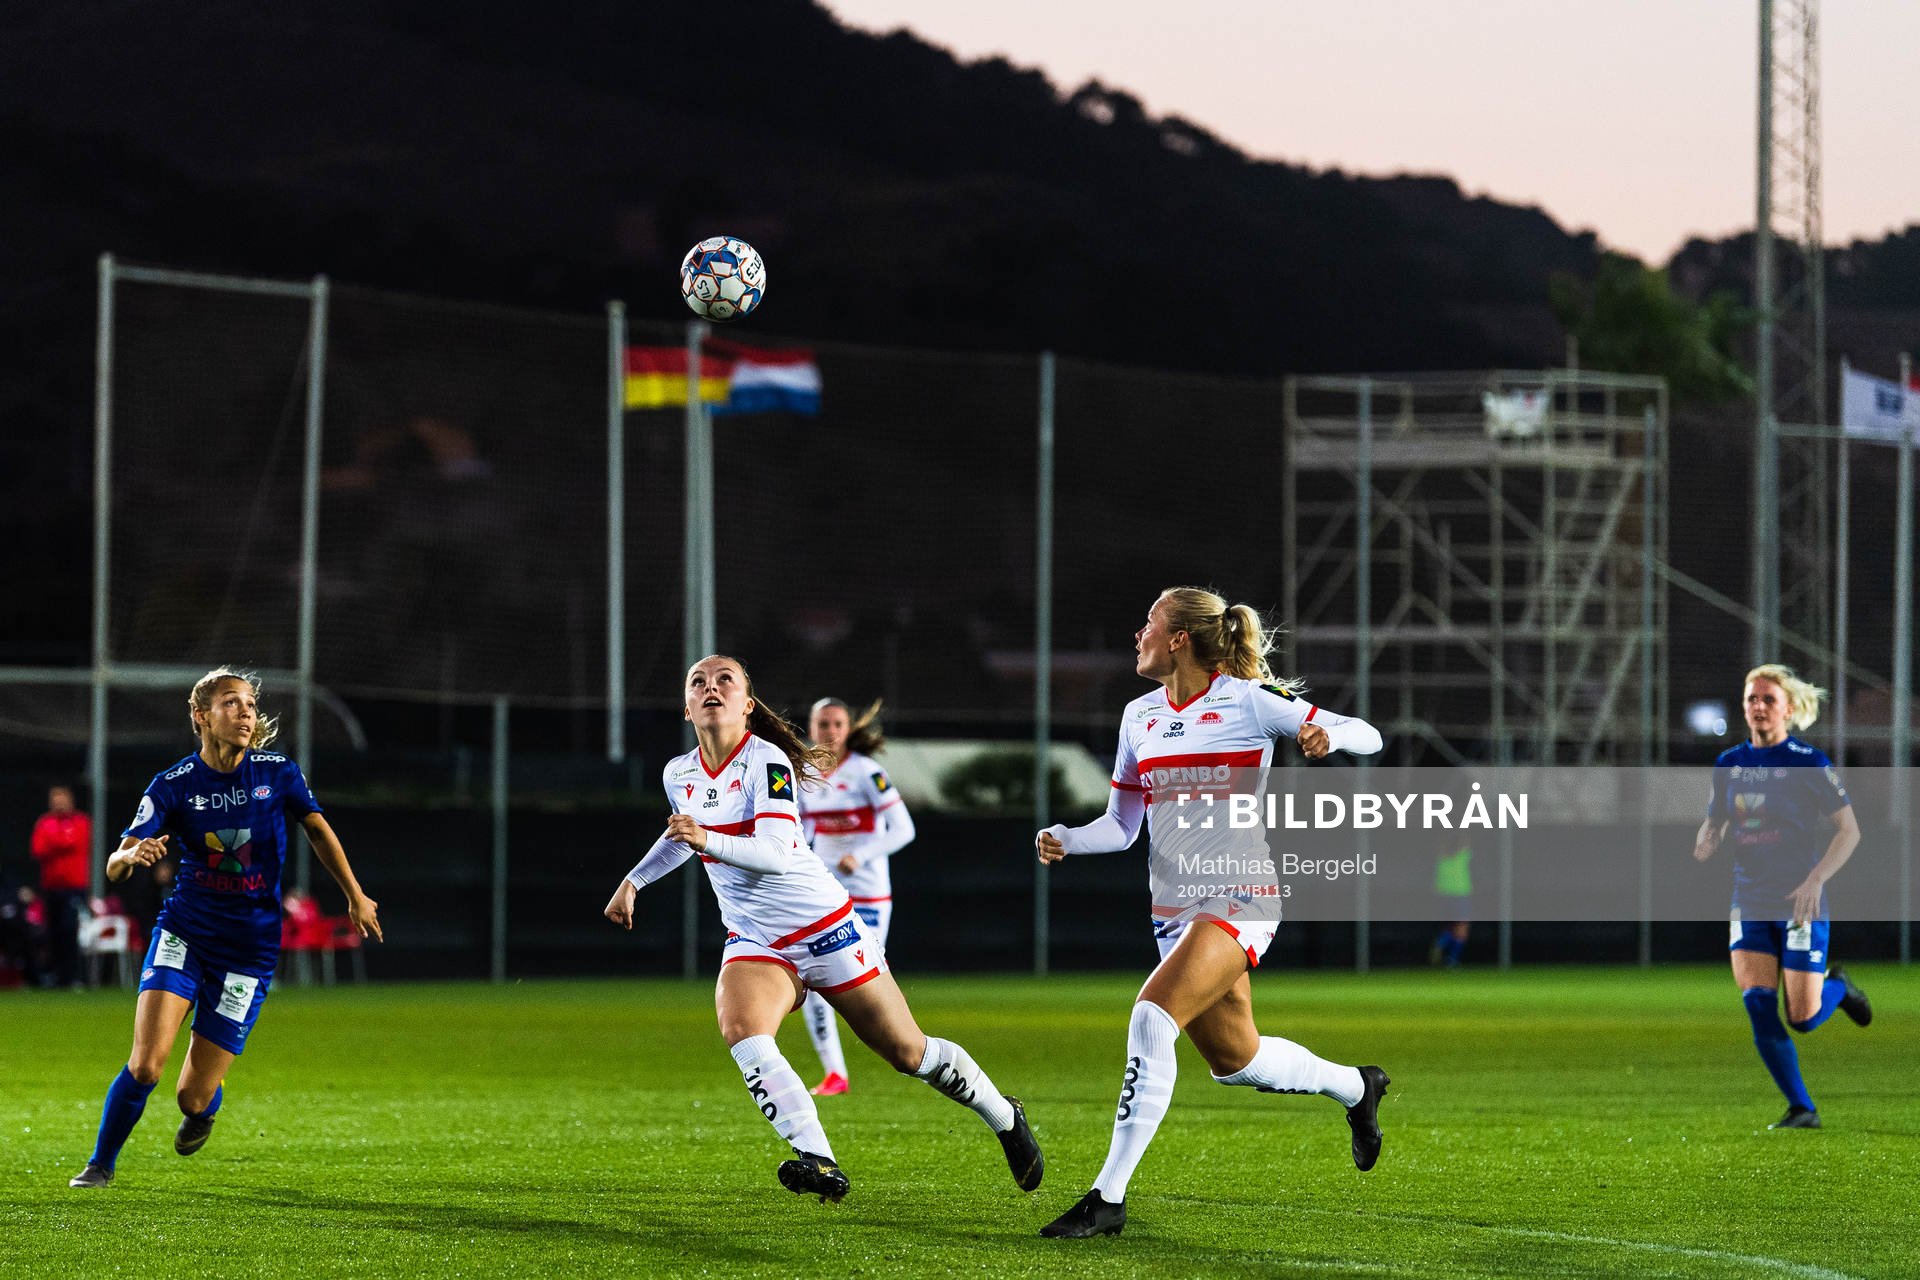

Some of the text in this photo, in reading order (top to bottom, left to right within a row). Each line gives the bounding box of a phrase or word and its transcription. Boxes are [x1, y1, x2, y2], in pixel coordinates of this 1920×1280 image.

[1162, 730, 1185, 739] OBOS
[250, 754, 287, 764] coop
[164, 762, 195, 781] coop
[211, 786, 248, 813] DNB
[702, 800, 720, 809] OBOS
[195, 869, 267, 893] SABONA
